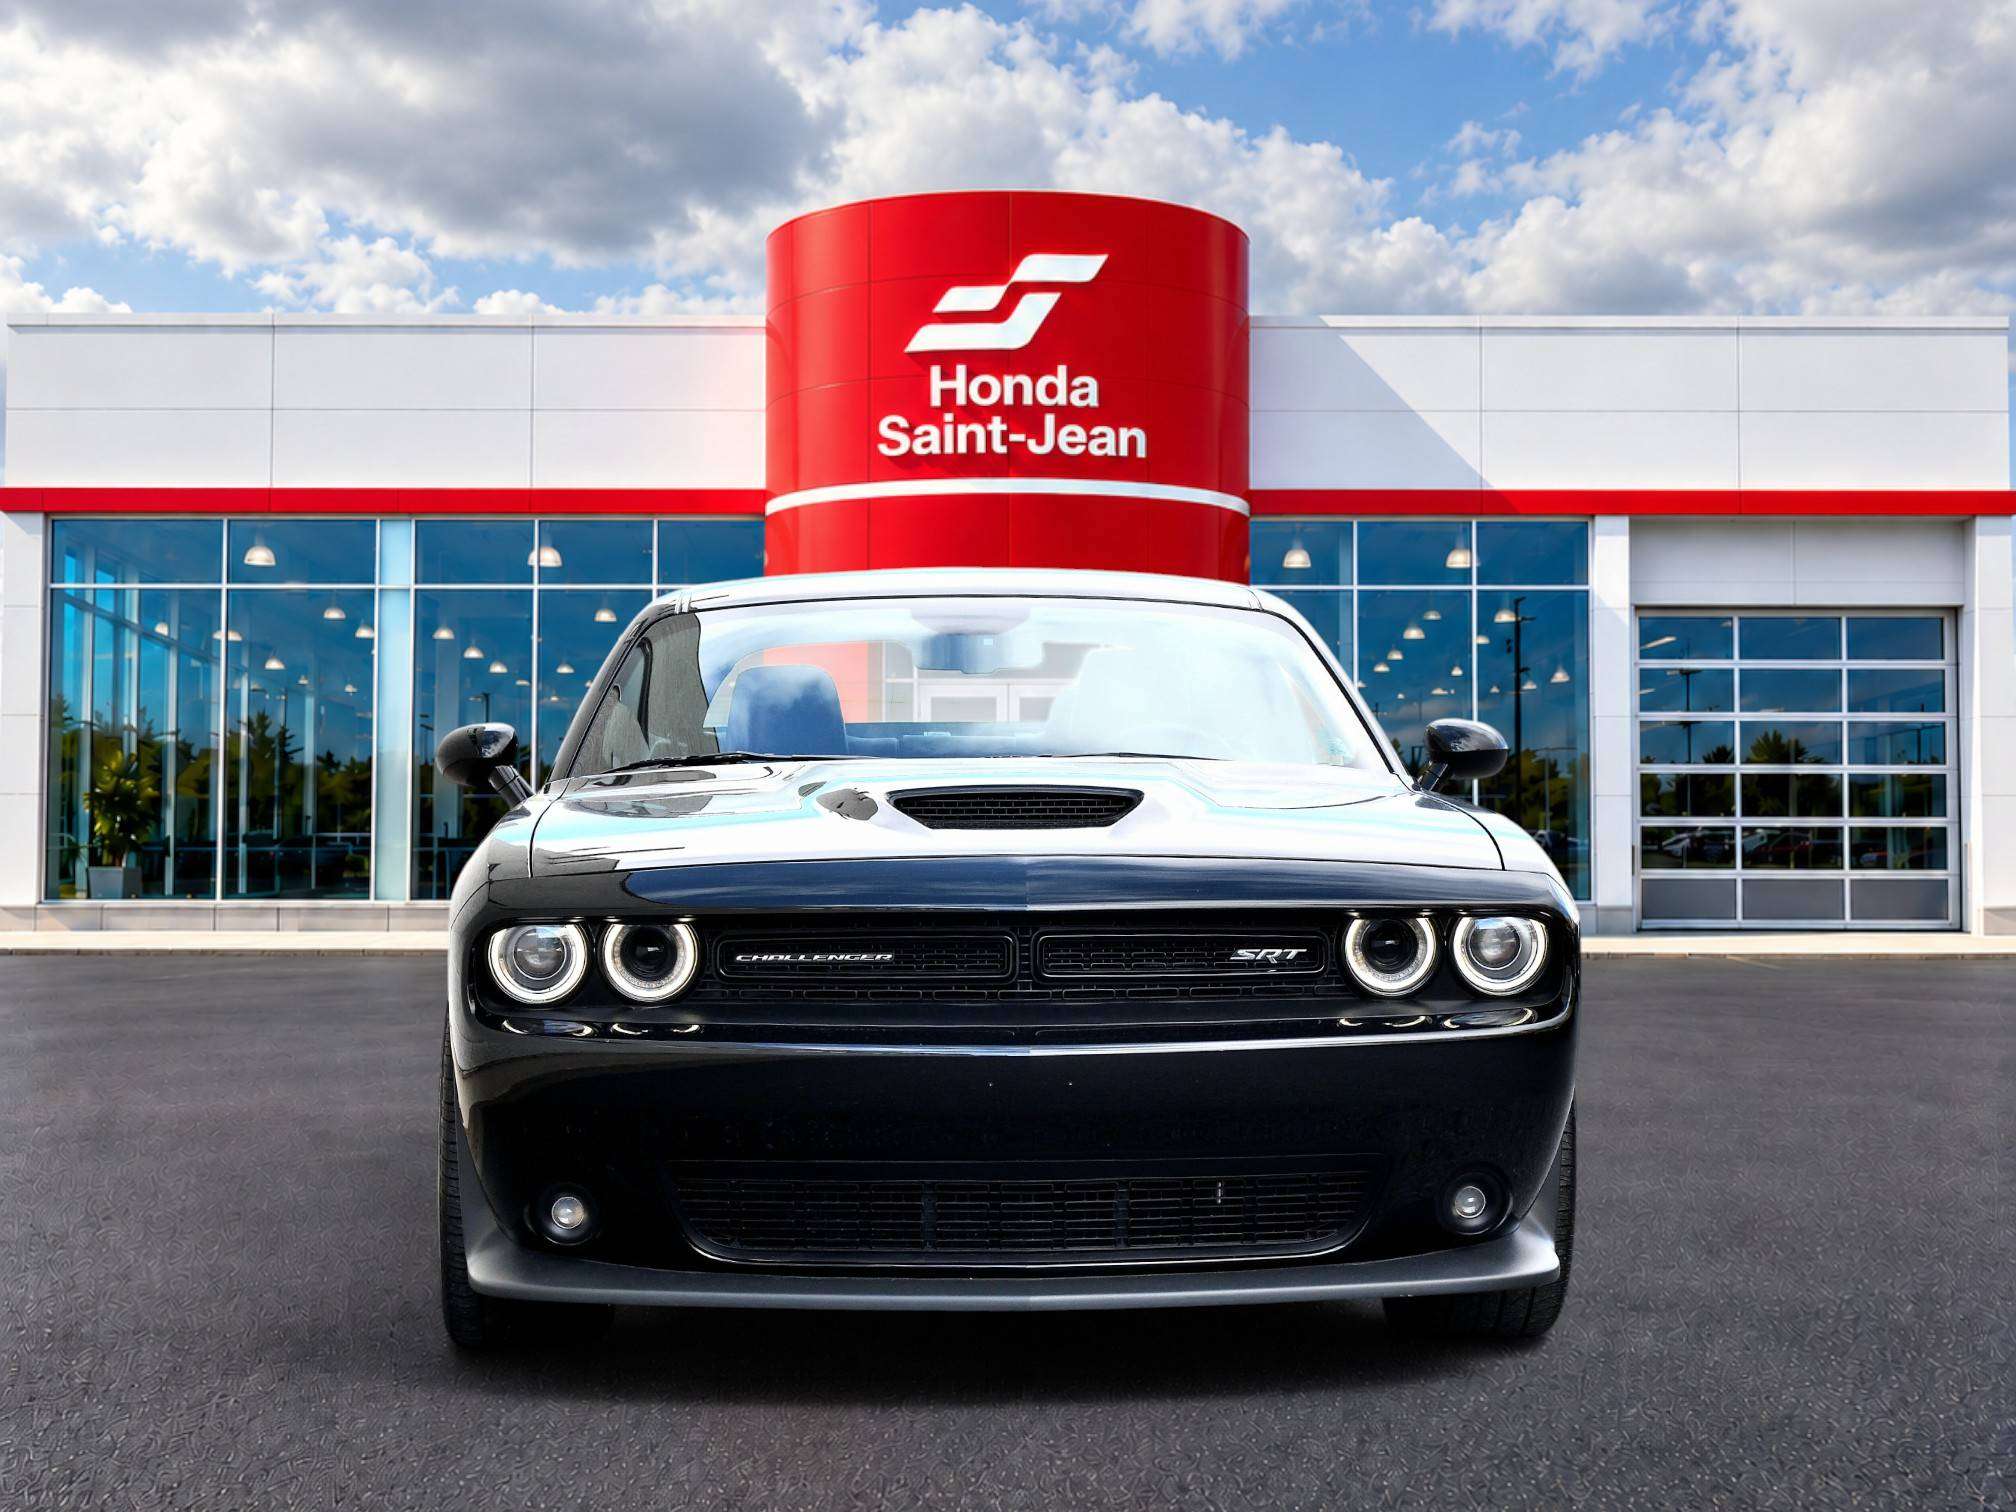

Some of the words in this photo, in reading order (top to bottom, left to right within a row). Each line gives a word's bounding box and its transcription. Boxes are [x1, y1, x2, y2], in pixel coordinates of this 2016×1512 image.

[929, 364, 1099, 407] Honda
[877, 412, 1147, 458] Saint-Jean
[735, 953, 894, 962] CHALLENGER
[1230, 948, 1308, 964] SRT
